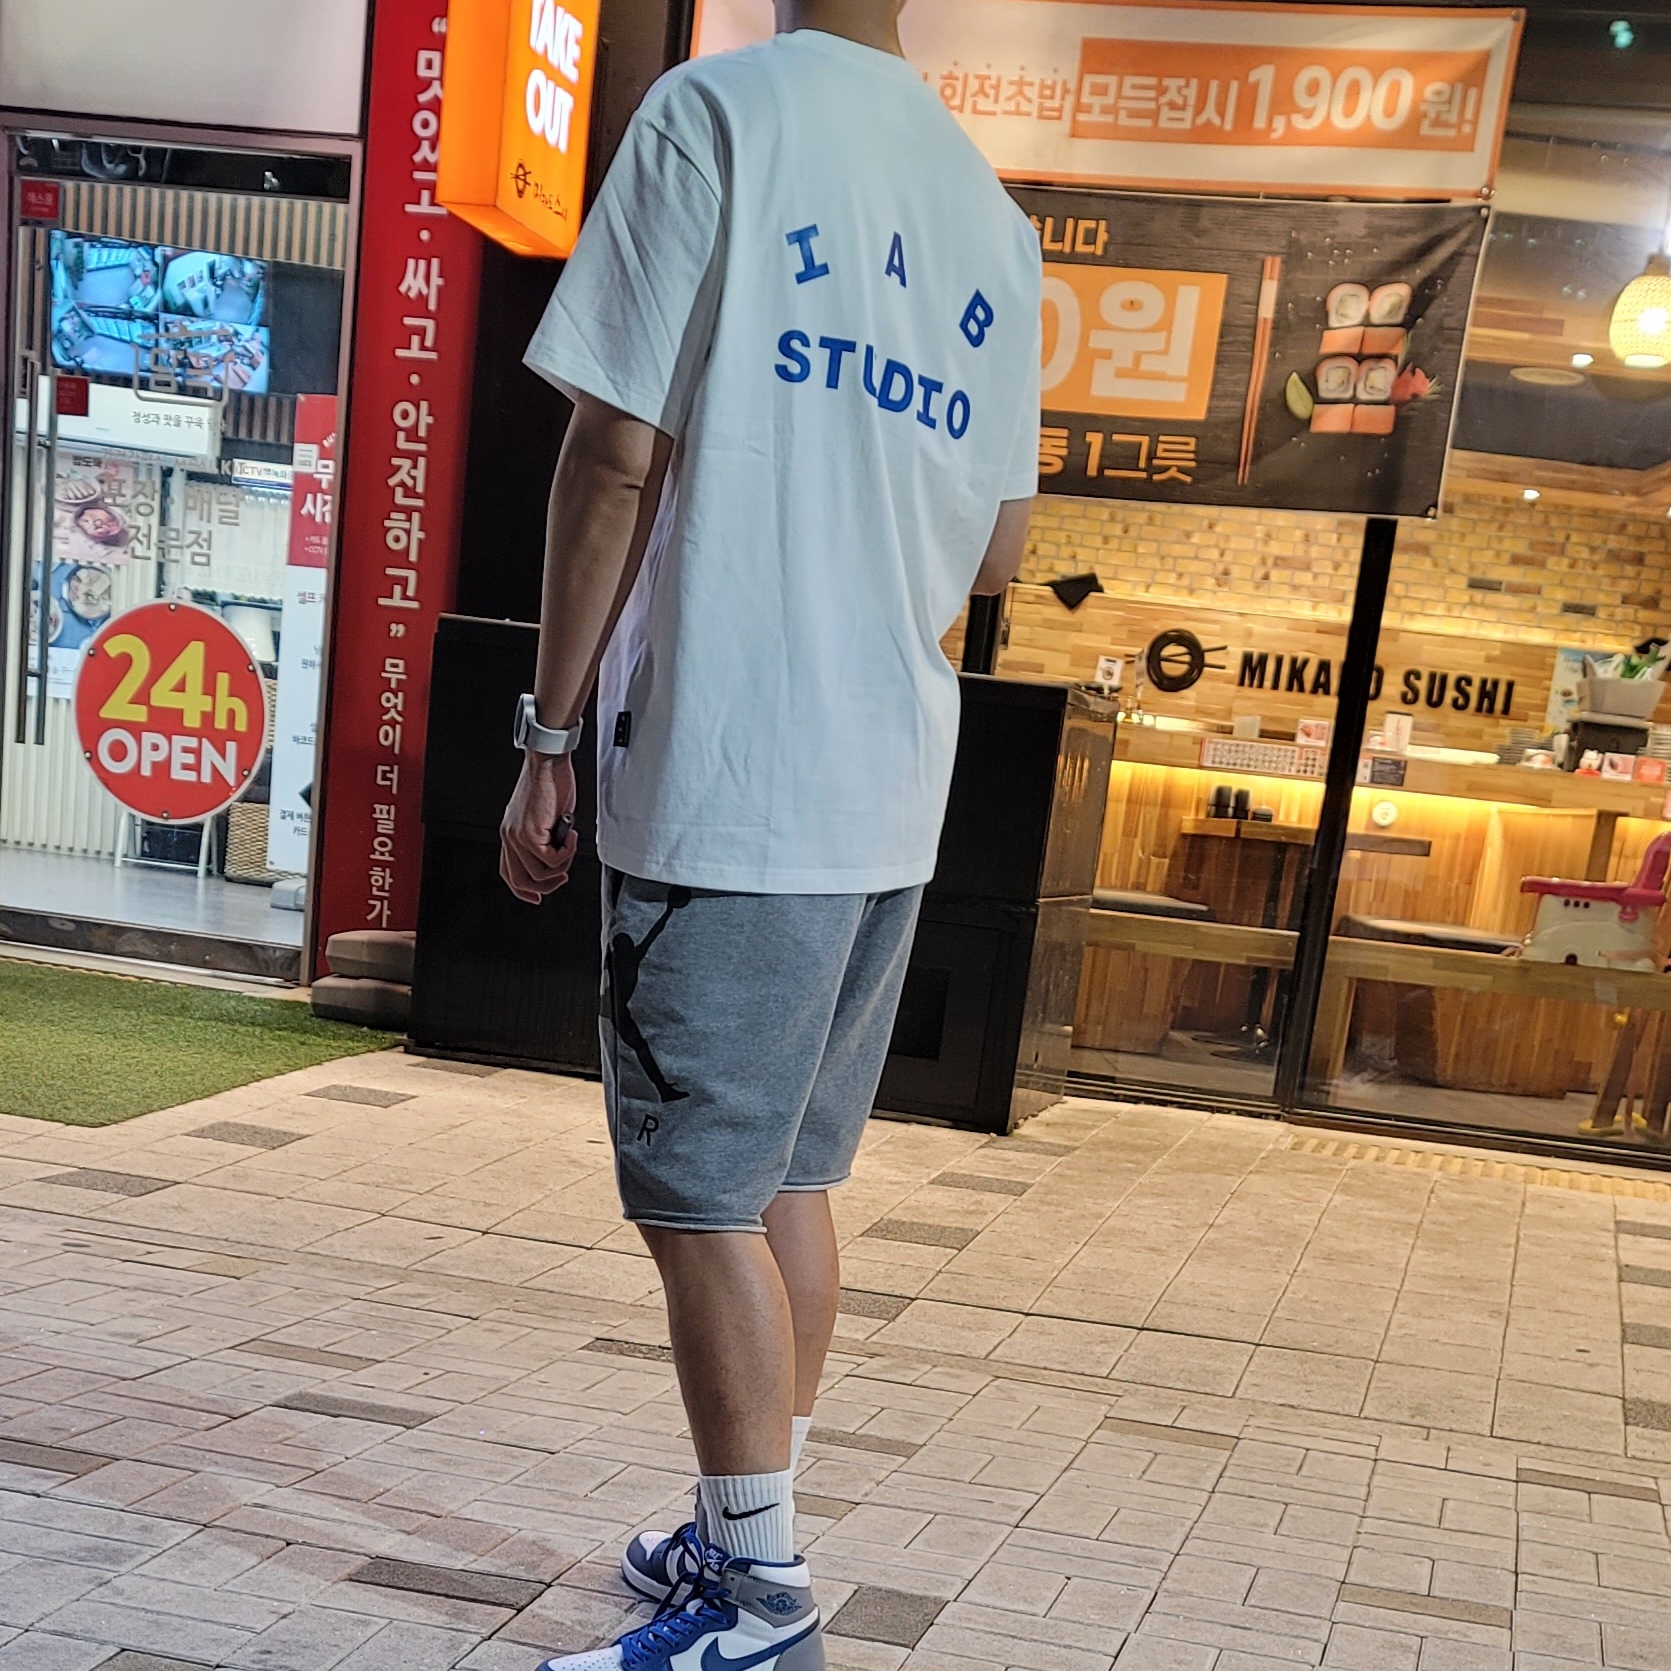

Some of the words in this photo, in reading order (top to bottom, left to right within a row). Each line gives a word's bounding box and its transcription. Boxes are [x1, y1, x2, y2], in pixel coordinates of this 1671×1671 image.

[528, 0, 584, 84] TAKE
[525, 68, 575, 155] OUT
[1074, 72, 1240, 132] 모든접시
[1246, 63, 1415, 140] 1,900
[773, 329, 971, 440] STUDIO
[1084, 431, 1198, 484] 1그릇
[98, 633, 248, 733] 24h
[378, 657, 408, 755] 무엇이
[1400, 667, 1516, 716] SUSHI
[97, 727, 237, 788] OPEN
[375, 763, 399, 795] 더
[366, 803, 397, 929] 필요한가
[636, 1113, 660, 1147] R
